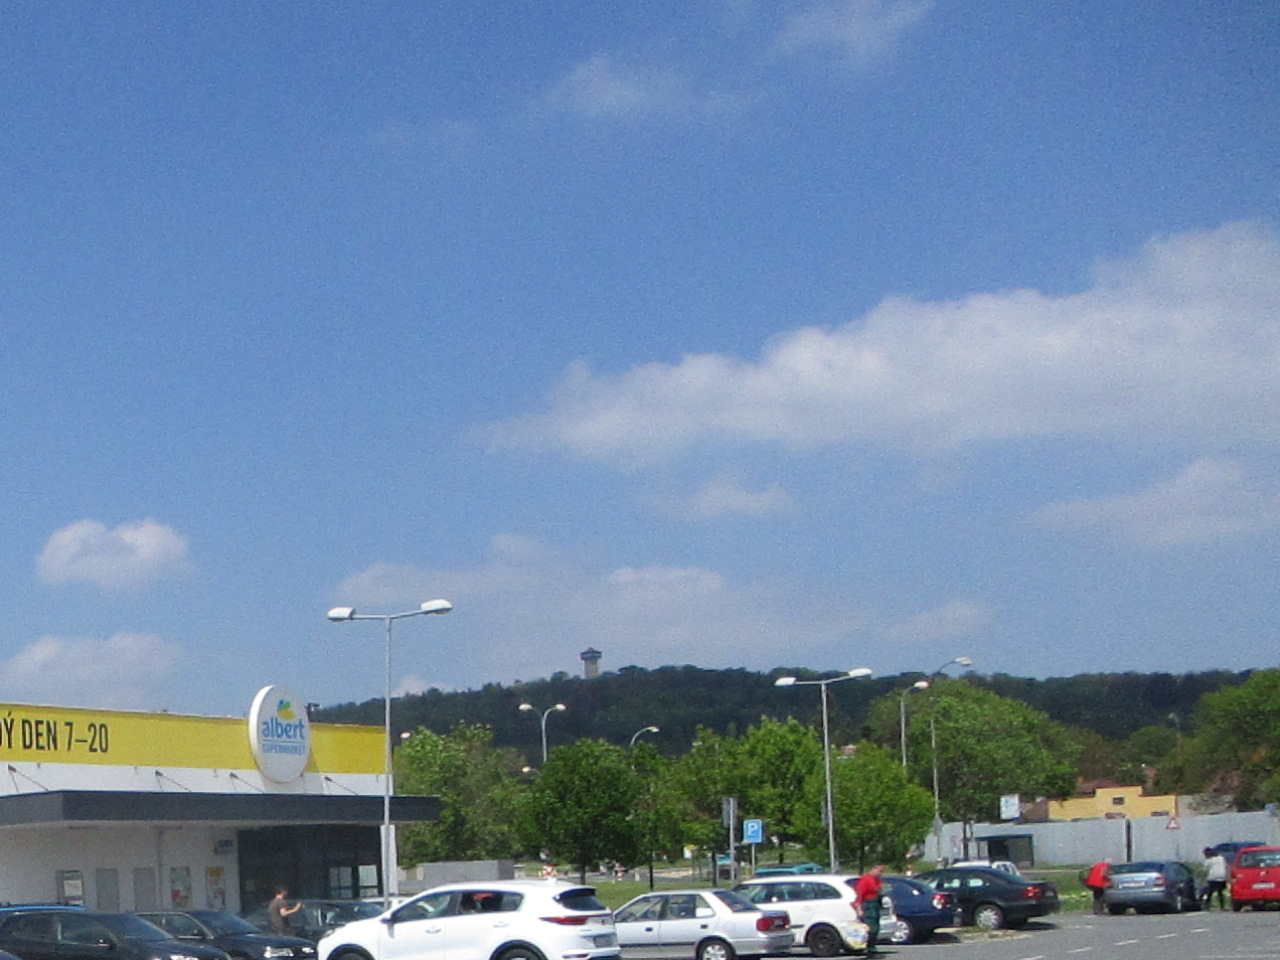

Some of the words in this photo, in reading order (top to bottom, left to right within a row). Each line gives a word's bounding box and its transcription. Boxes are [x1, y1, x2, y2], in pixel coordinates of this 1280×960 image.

[21, 717, 58, 751] DEN
[262, 717, 305, 739] albert
[747, 822, 758, 836] P
